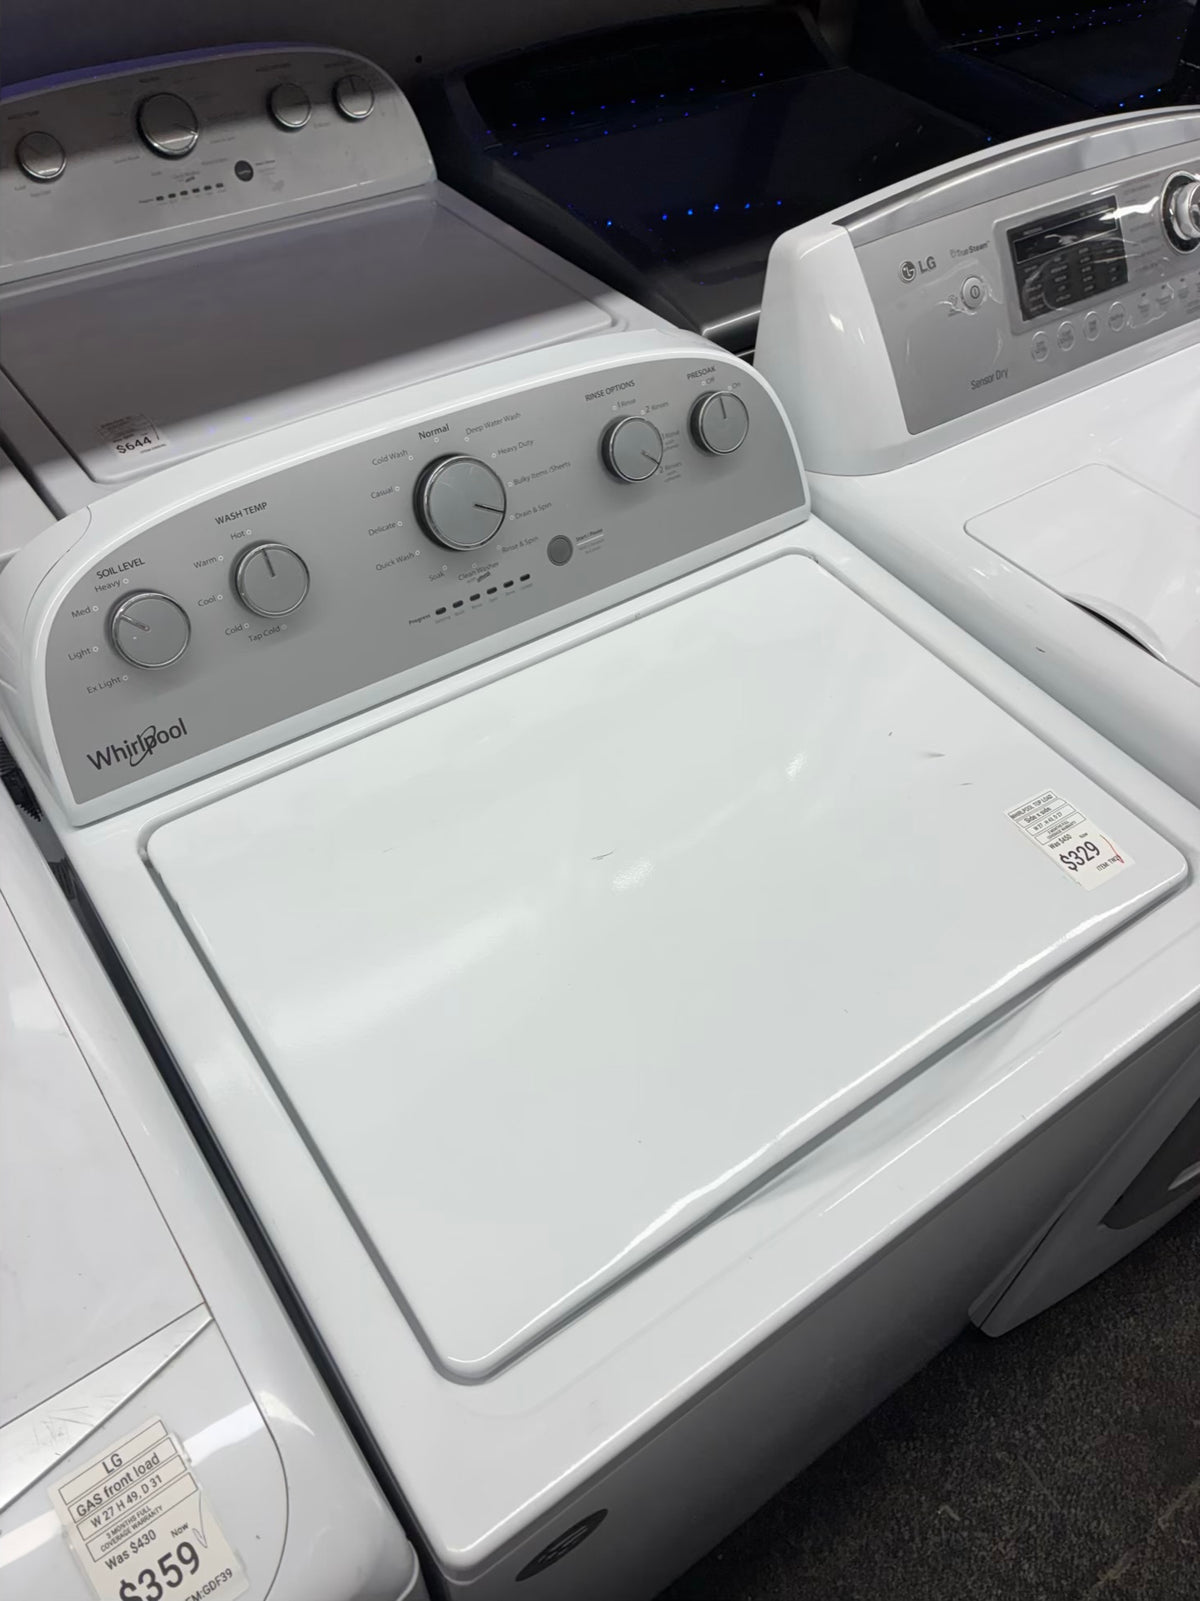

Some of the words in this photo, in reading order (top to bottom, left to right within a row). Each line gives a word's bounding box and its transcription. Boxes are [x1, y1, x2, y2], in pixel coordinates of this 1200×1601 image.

[917, 255, 937, 275] LG
[686, 365, 716, 380] PRESOAK
[705, 376, 715, 385] Off
[970, 371, 995, 391] Sensor
[995, 366, 1009, 383] Dry
[584, 388, 606, 402] RINSE
[605, 379, 636, 395] OPTIONS
[418, 424, 450, 440] Normal
[464, 424, 483, 436] Deep
[482, 418, 503, 431] Water
[501, 412, 521, 425] Wash
[371, 454, 390, 466] Cold
[389, 449, 409, 462] Wash
[497, 445, 517, 457] Heavy
[516, 439, 536, 450] Duty
[513, 473, 531, 486] Bulky
[370, 486, 394, 499] Casual
[215, 510, 243, 526] WASH
[243, 502, 268, 516] TEMP
[514, 509, 533, 520] Drain
[538, 501, 553, 513] Spin
[230, 529, 246, 541] Hot
[368, 521, 397, 536] Delicate
[501, 543, 519, 555] Rinse
[524, 535, 540, 547] Spin
[96, 567, 118, 580] SOIL
[118, 558, 146, 573] LEVEL
[193, 555, 218, 570] Warm
[375, 557, 397, 572] Quick
[395, 551, 415, 564] Wash
[457, 569, 477, 581] Clean
[475, 560, 501, 575] Washer
[94, 578, 121, 593] Heavy
[428, 570, 446, 582] Soak
[197, 595, 217, 608] Cool
[70, 606, 91, 620] Med
[408, 614, 432, 625] Progress
[224, 624, 244, 637] Cold
[248, 631, 263, 644] Tap
[263, 624, 282, 638] Cold
[68, 647, 92, 662] Light
[86, 684, 98, 695] Ex
[98, 676, 122, 692] Light
[86, 717, 188, 771] Whirlpool
[1024, 814, 1037, 823] Side
[1048, 841, 1061, 849] Was
[1059, 841, 1100, 872] $329
[102, 1453, 123, 1474] LG
[76, 1493, 104, 1517] GAS
[103, 1471, 133, 1498] front
[133, 1452, 161, 1477] load
[91, 1516, 102, 1528] W
[102, 1507, 116, 1520] 27
[117, 1500, 127, 1512] H
[126, 1490, 142, 1506] 49,
[140, 1484, 151, 1496] D
[150, 1474, 164, 1488] 31
[100, 1530, 133, 1553] COVERAGE
[131, 1505, 164, 1533] WARRANTY
[110, 1516, 134, 1537] MONTHS
[133, 1505, 152, 1522] FULL
[170, 1522, 189, 1538] Now
[105, 1551, 130, 1571] Was
[129, 1529, 157, 1554] $430
[119, 1541, 200, 1601] $359
